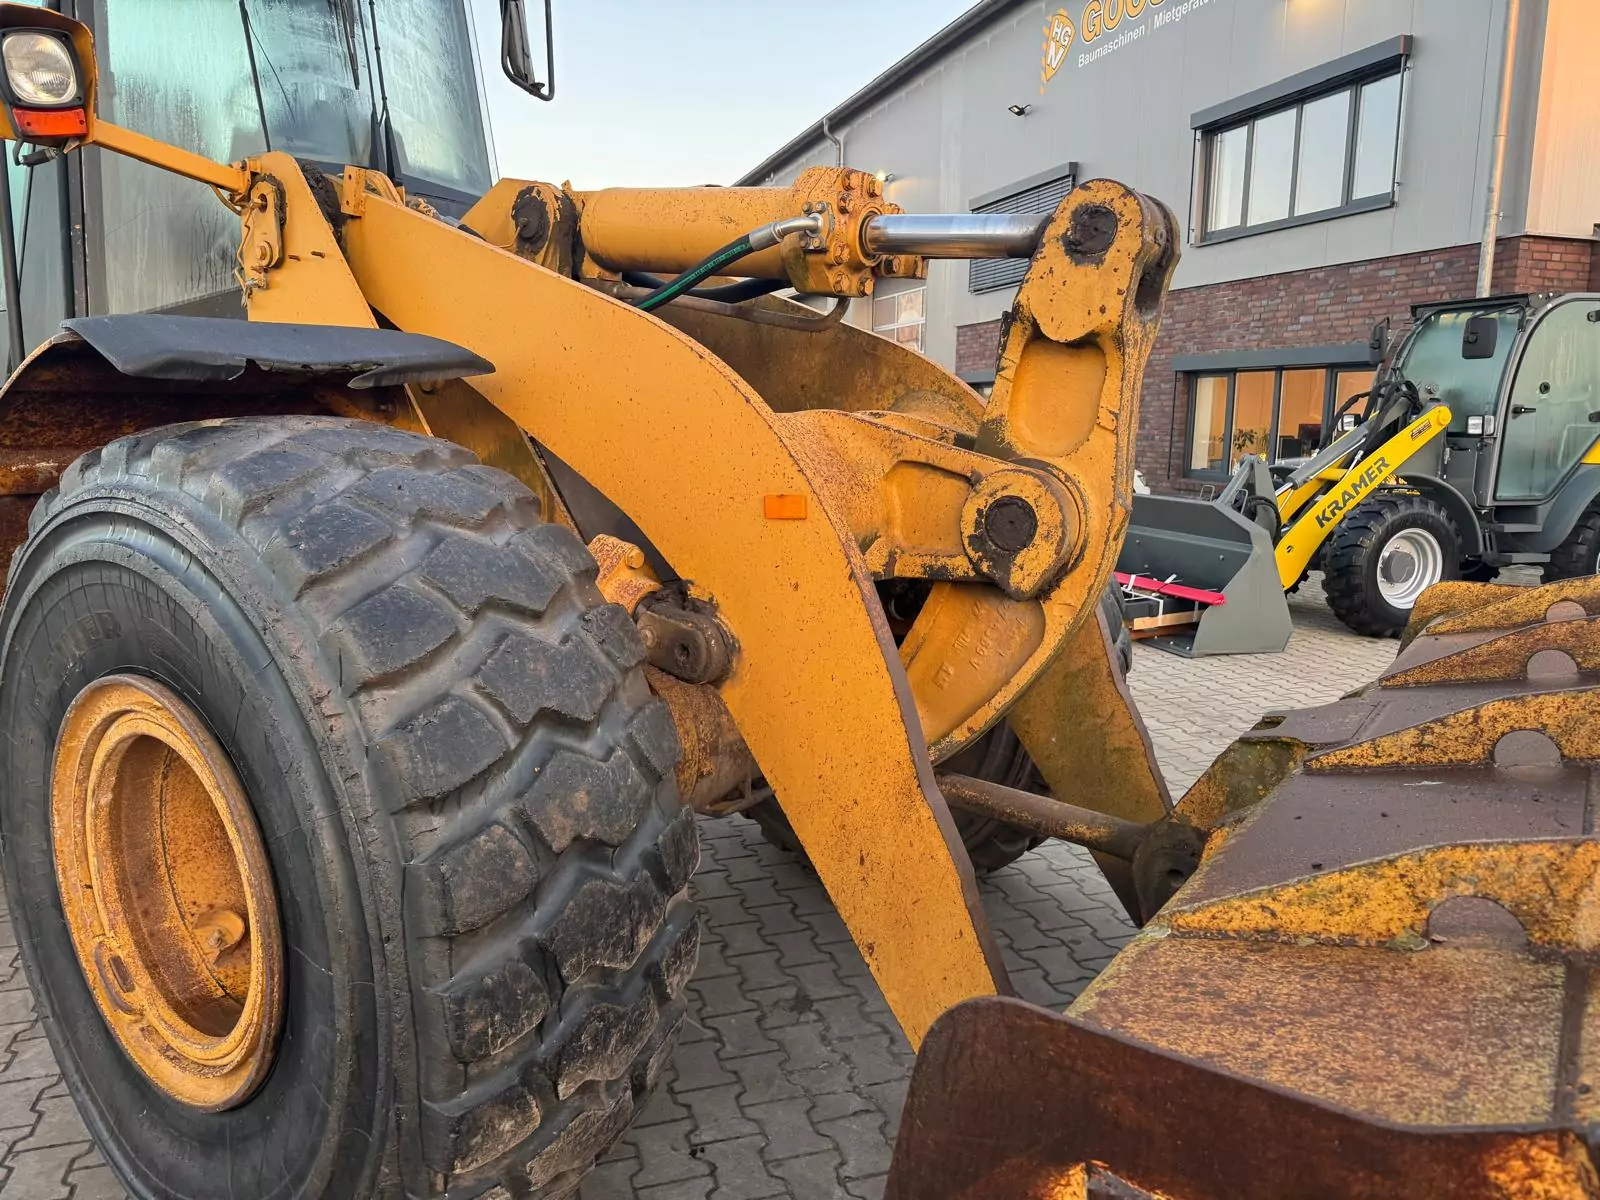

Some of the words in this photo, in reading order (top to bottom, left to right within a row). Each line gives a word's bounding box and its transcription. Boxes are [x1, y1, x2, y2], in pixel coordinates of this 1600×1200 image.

[1081, 0, 1167, 44] GOO
[1078, 24, 1145, 68] Baumaschinen
[1315, 457, 1391, 529] KRAMER
